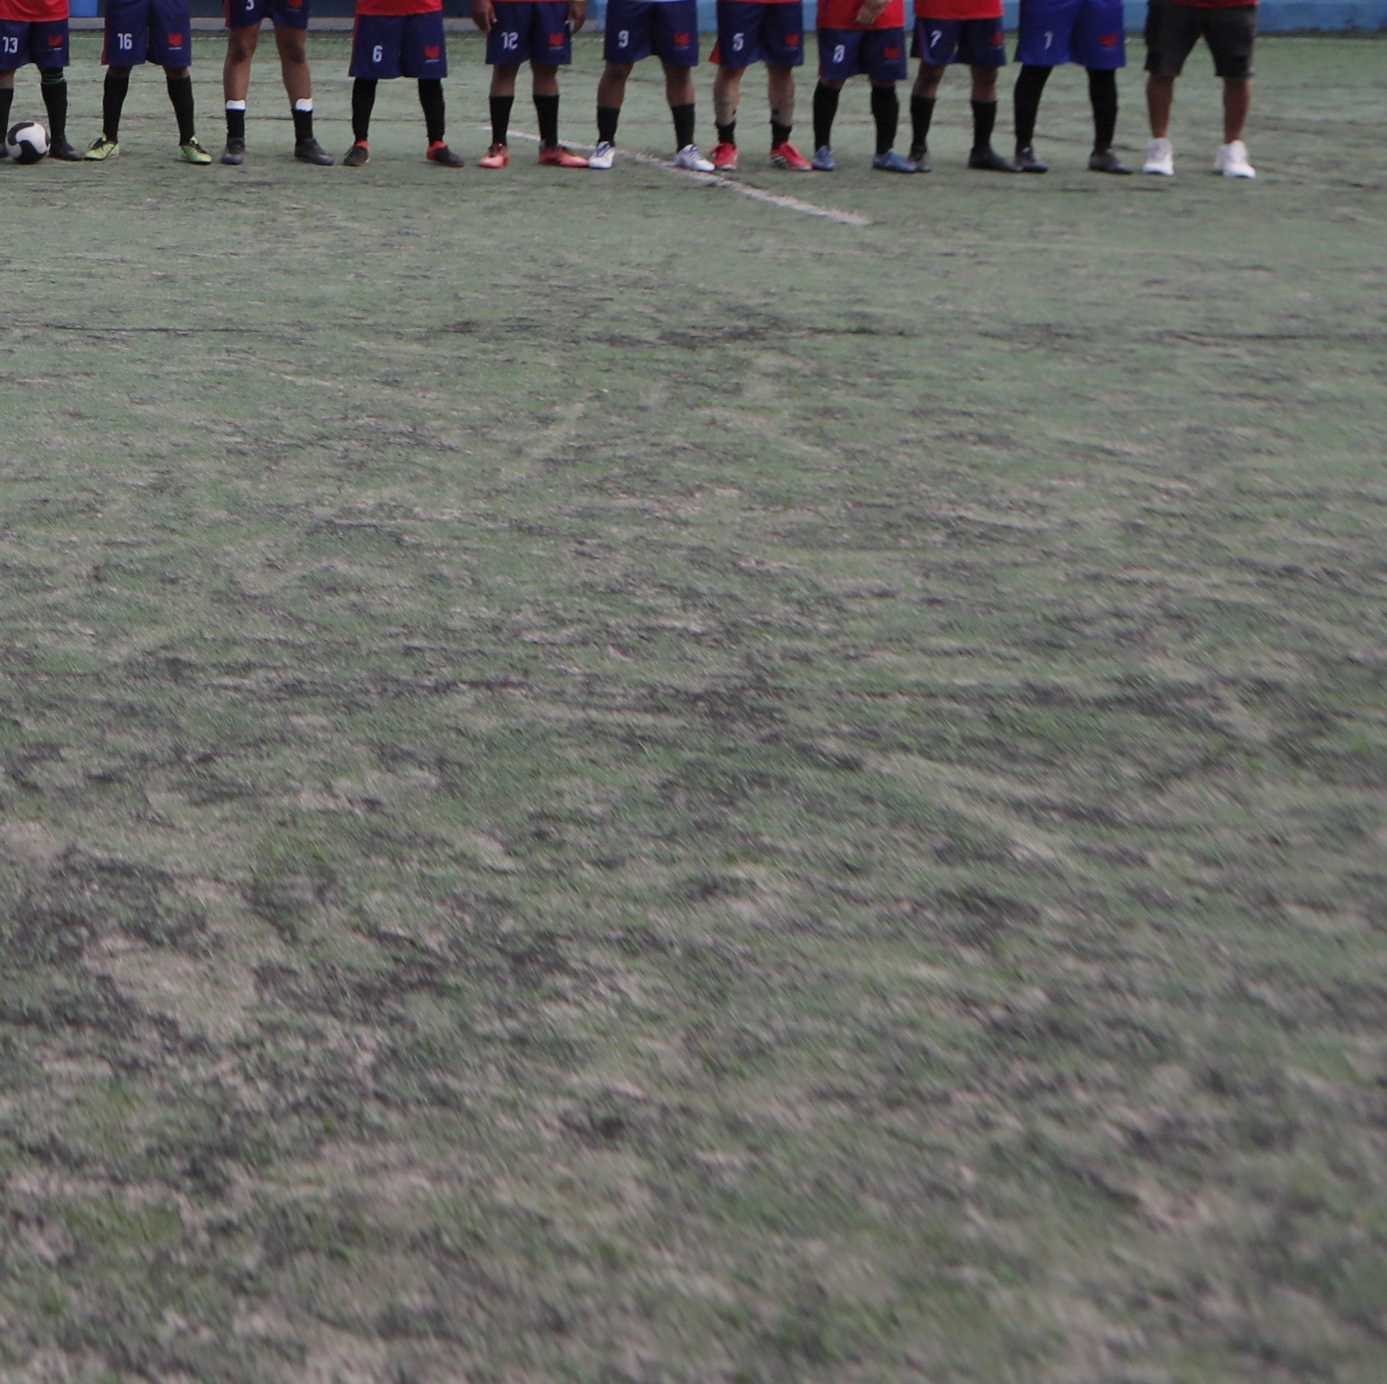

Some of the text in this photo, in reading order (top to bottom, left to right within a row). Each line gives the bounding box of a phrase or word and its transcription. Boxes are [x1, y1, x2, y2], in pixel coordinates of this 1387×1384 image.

[3, 36, 18, 54] 13
[118, 32, 132, 50] 16
[501, 31, 518, 50] 12
[733, 32, 744, 51] 5
[373, 45, 382, 63] 6
